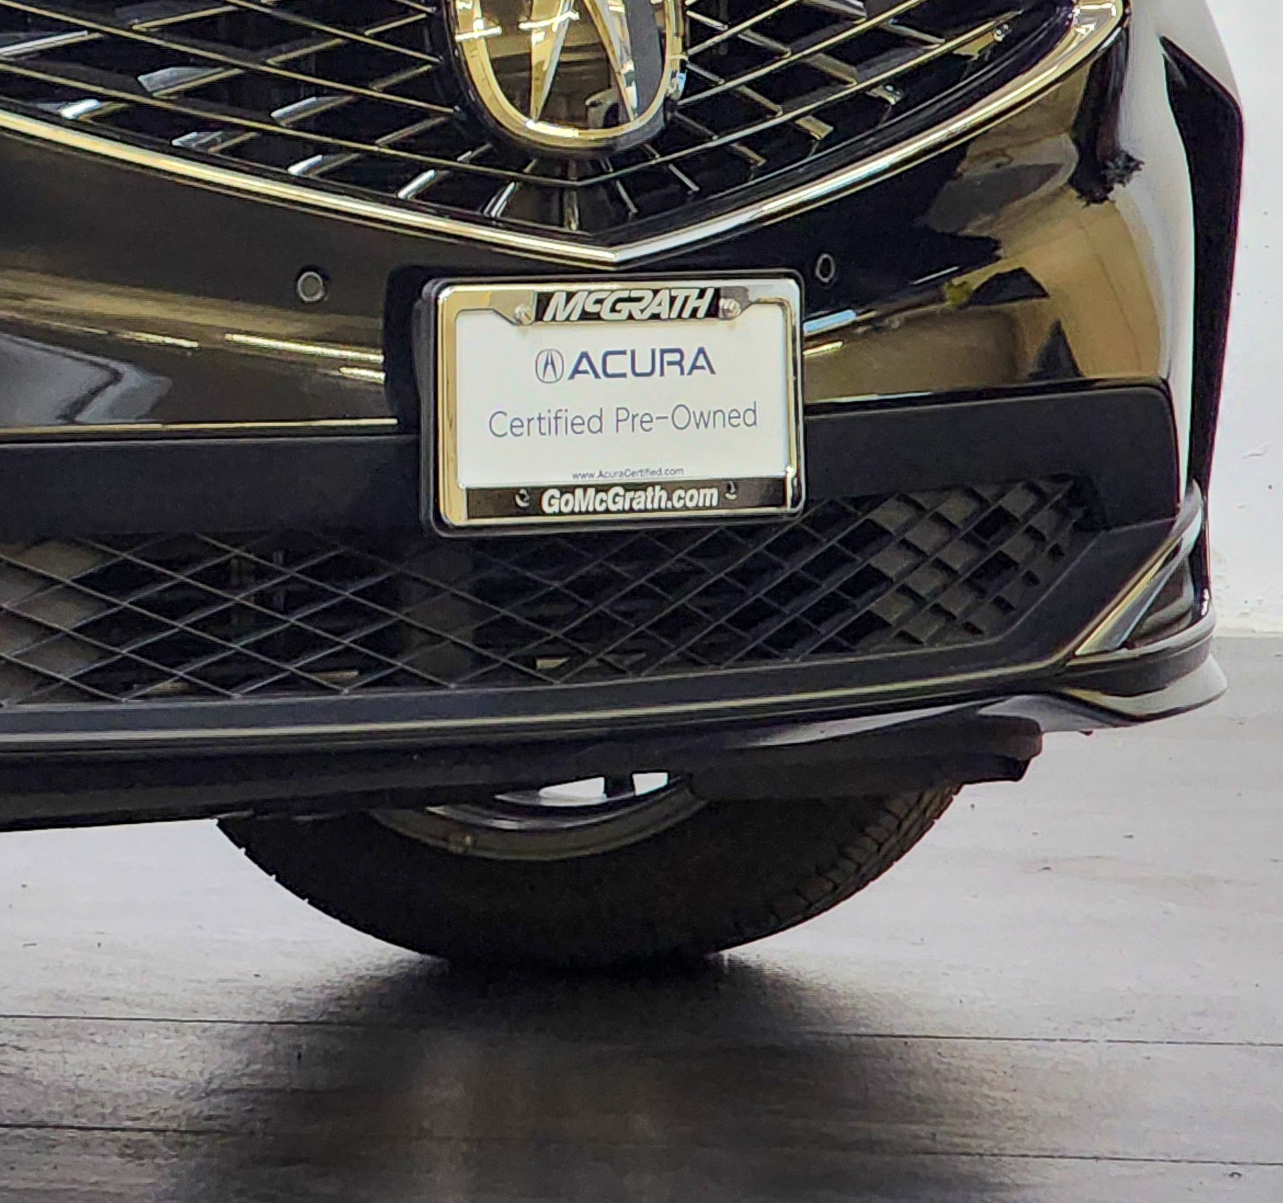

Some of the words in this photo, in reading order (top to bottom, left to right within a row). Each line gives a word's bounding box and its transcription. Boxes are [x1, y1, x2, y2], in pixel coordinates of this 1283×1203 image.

[567, 346, 716, 381] ACURA
[488, 407, 604, 439] Certified
[615, 402, 758, 434] Pre-Owned
[572, 467, 684, 480] www.AcuraCertified.com
[541, 485, 719, 514] GoMcGrath.com
